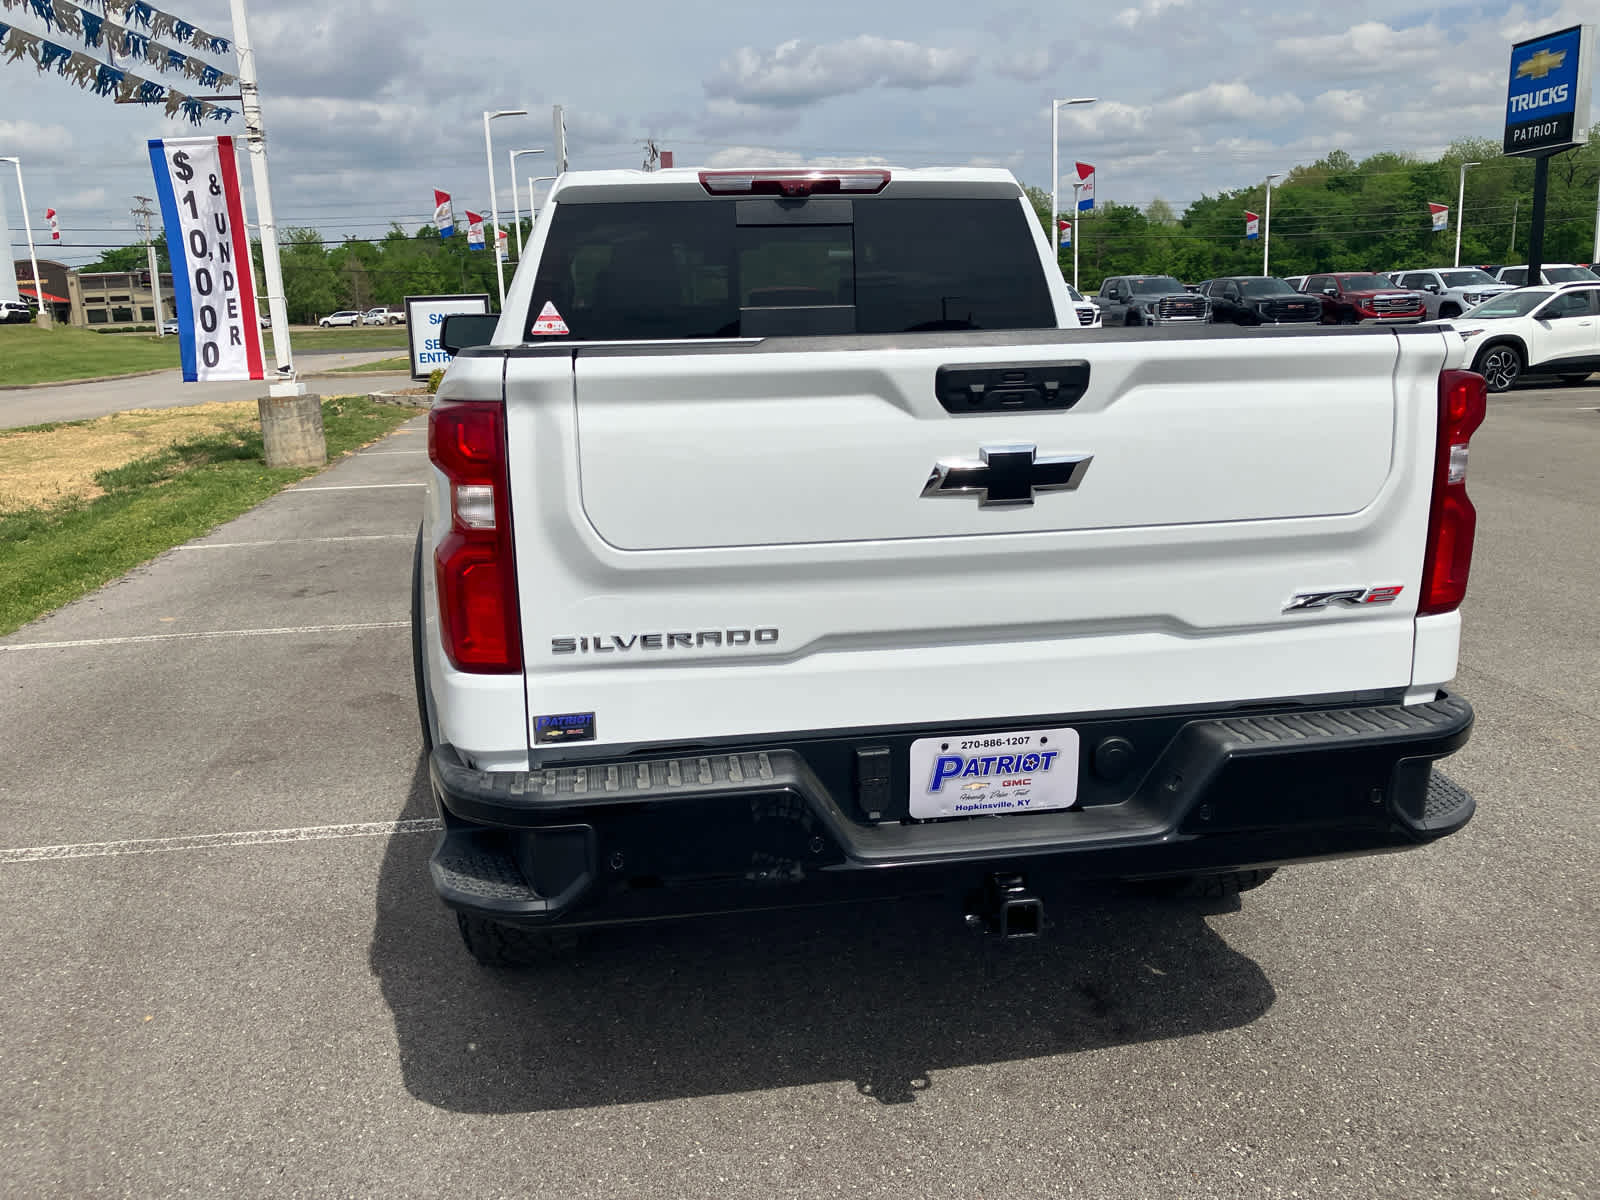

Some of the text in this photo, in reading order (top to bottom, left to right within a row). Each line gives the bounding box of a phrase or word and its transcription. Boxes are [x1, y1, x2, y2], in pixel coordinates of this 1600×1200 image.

[1510, 84, 1568, 112] TRUCKS
[1514, 122, 1558, 141] PATRIOT
[214, 212, 242, 346] UNDER
[1281, 584, 1404, 615] ZR2
[551, 627, 779, 654] SILVERADO
[961, 736, 1031, 749] 270-886-1207
[929, 752, 1058, 793] PATRIOT
[1002, 778, 1032, 787] GMC
[955, 801, 1015, 811] Hopkinsville,
[1017, 799, 1031, 807] KY
